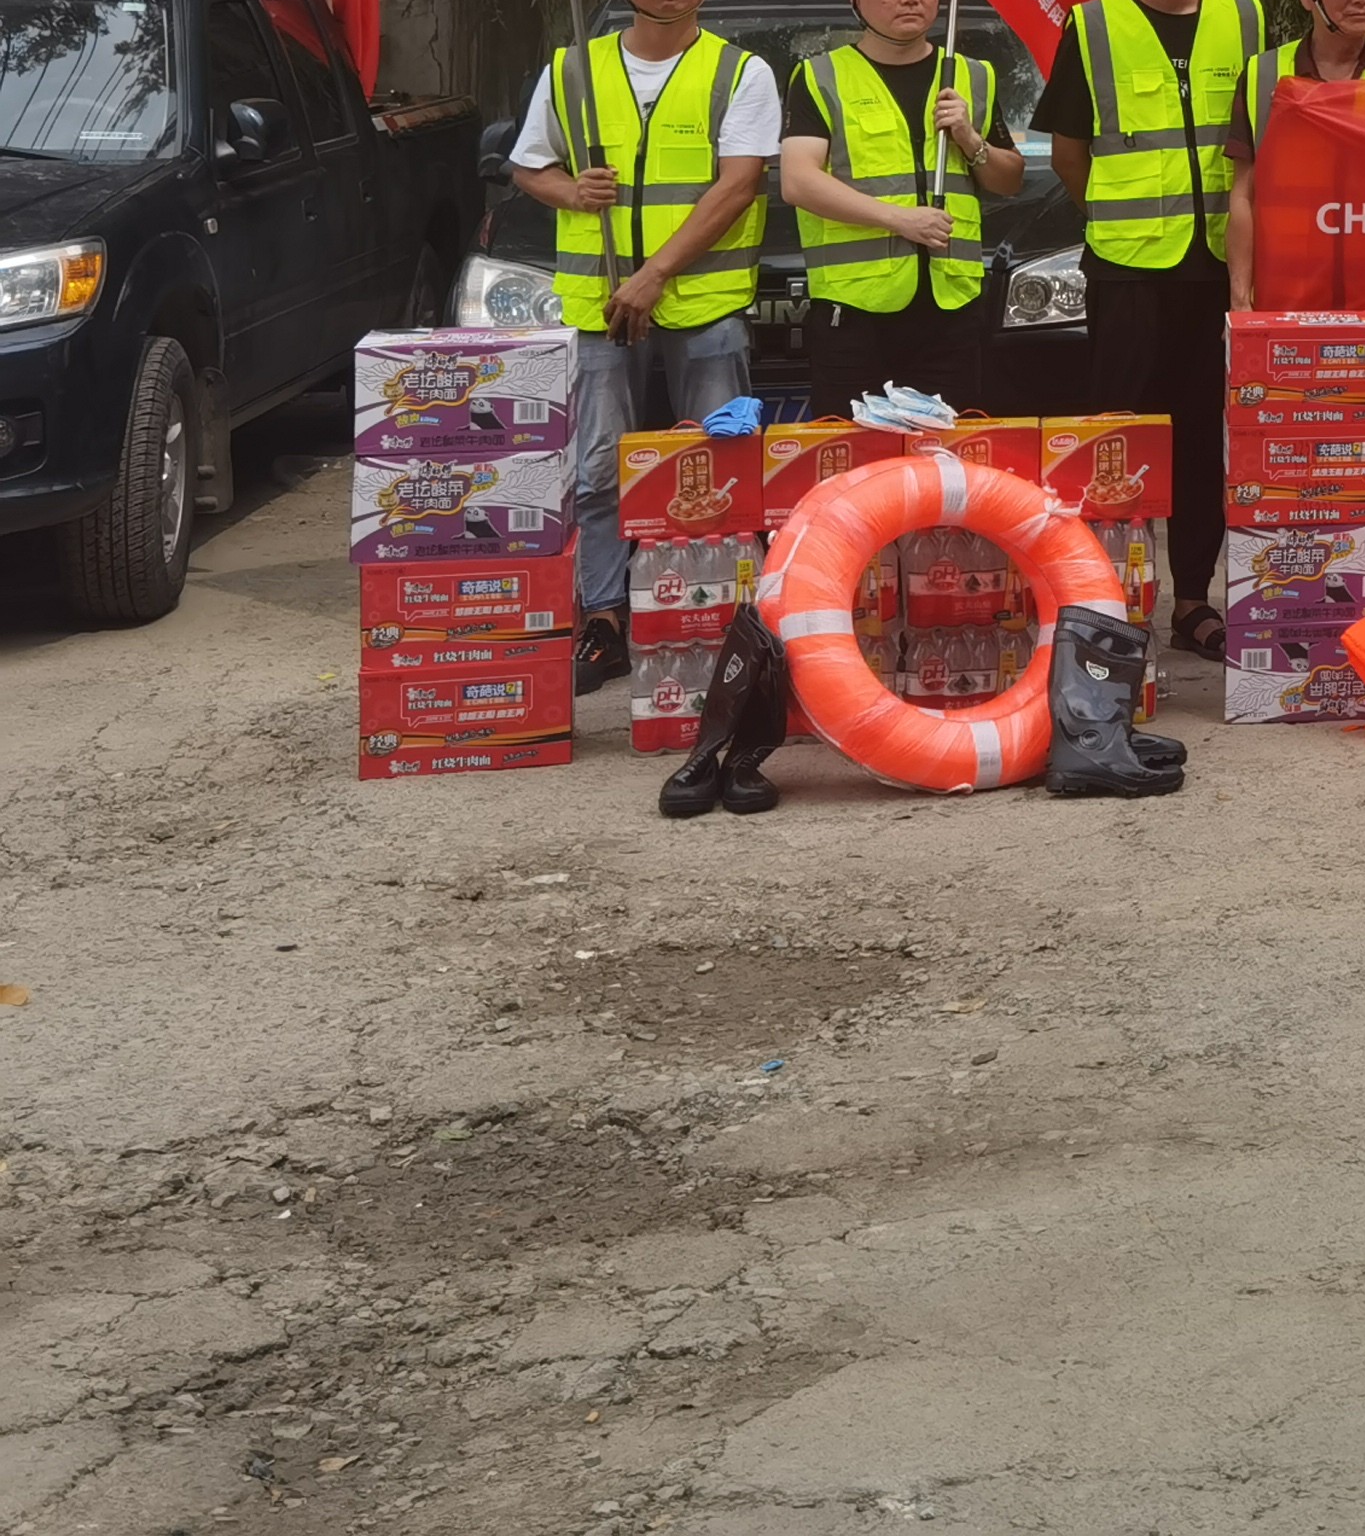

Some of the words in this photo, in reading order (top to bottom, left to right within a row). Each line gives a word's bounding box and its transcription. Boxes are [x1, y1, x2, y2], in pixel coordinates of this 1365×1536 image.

[750, 299, 811, 324] JM
[402, 372, 470, 389] 老坛酸菜
[415, 388, 458, 400] 牛肉面
[397, 480, 464, 497] 老坛酸菜
[410, 497, 453, 509] 牛肉面
[1268, 549, 1326, 564] 老坛酸菜
[932, 567, 956, 583] pH
[1279, 565, 1316, 576] 牛肉面
[657, 577, 684, 596] pH
[922, 663, 946, 684] pH
[656, 685, 683, 703] pH
